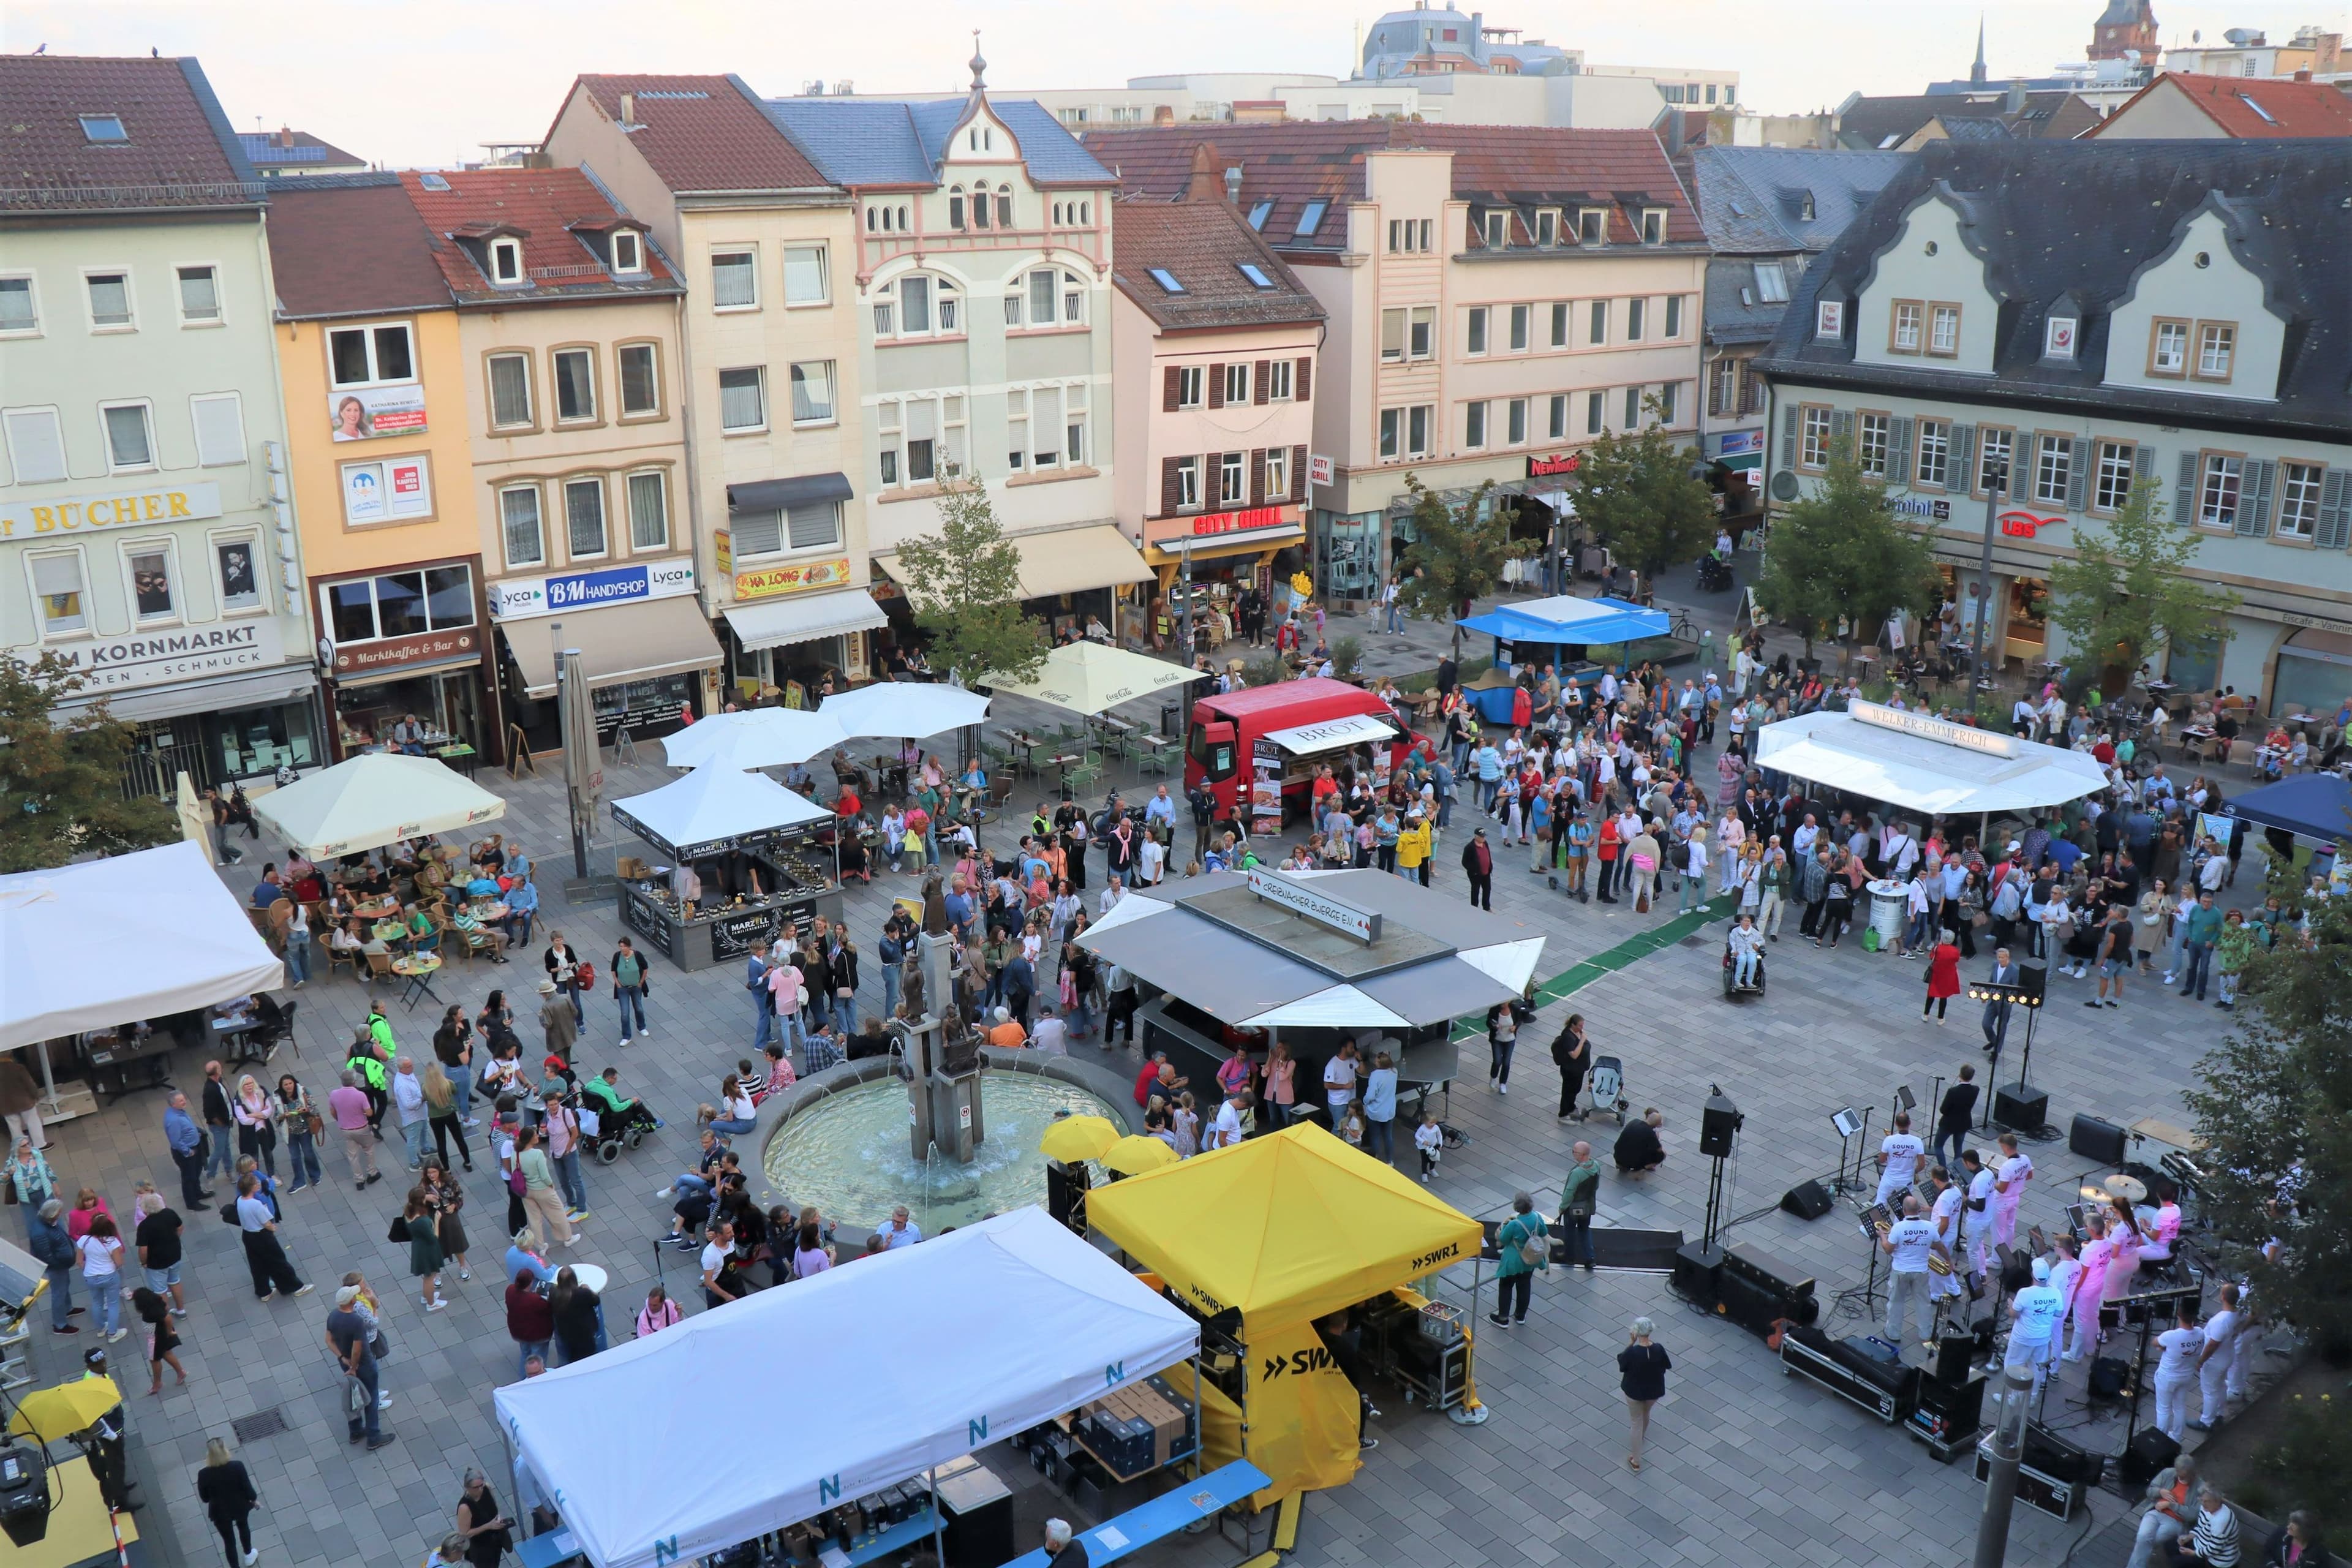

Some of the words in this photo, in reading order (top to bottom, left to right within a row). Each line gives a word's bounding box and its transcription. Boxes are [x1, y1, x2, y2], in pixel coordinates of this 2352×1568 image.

[1313, 458, 1329, 469] CITY
[1312, 470, 1329, 482] GRILL
[30, 491, 192, 533] BÜCHER
[1194, 512, 1233, 535] CITY
[1238, 506, 1283, 529] GRILL
[2002, 520, 2036, 538] LBS
[1936, 554, 1960, 566] Eiscafé
[654, 570, 684, 584] Lyca
[502, 590, 531, 606] yca
[549, 580, 585, 604] BM
[586, 579, 646, 599] HANDYSHOP
[2282, 613, 2313, 625] Eiscafé
[2321, 620, 2352, 633] Vannin
[92, 625, 255, 664] KORNMARKT
[357, 646, 420, 665] Marktkaffee
[422, 643, 431, 654] &
[433, 641, 453, 652] Bar
[164, 652, 261, 675] SCHMUCK
[1295, 720, 1365, 741] BROT
[1872, 708, 1987, 748] WELKER-EMMERICH
[1254, 743, 1279, 755] BROT
[467, 809, 491, 822] Segafredo
[397, 823, 421, 838] Segafredo
[323, 841, 348, 856] Segafredo
[693, 842, 728, 854] MARZLL
[731, 916, 769, 932] MARZLL
[1341, 914, 1354, 927] E.V.
[1424, 1242, 1460, 1267] SWR1
[1291, 1346, 1339, 1375] SW
[1106, 1360, 1125, 1387] N
[969, 1414, 987, 1447] N
[819, 1473, 840, 1506] N
[655, 1534, 679, 1567] N
